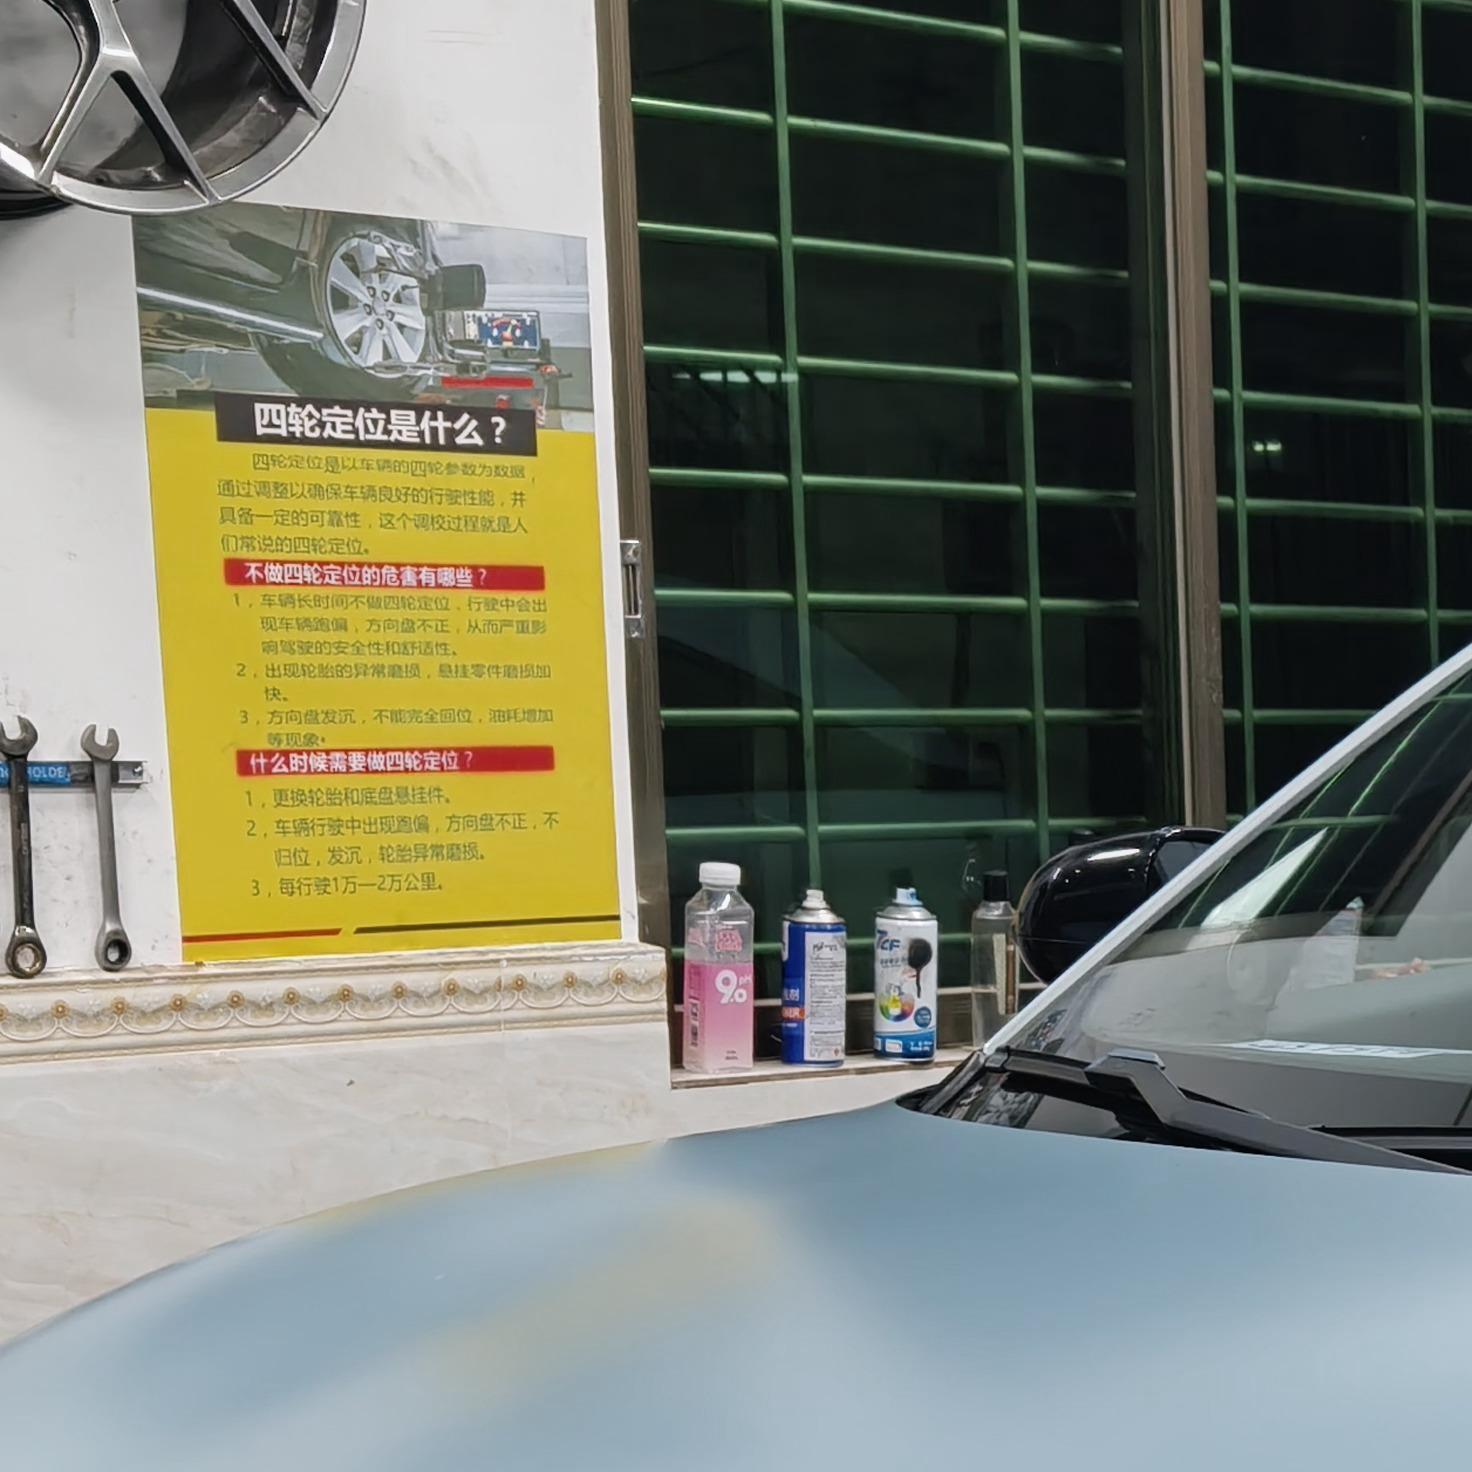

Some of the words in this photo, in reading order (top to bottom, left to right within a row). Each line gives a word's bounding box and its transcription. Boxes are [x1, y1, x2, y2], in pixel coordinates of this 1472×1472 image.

[254, 403, 507, 446] 四轮定位是什么？
[245, 562, 487, 588] 不做四轮定位的危害有哪些？
[250, 751, 474, 774] 什么时候需要做四轮定位？
